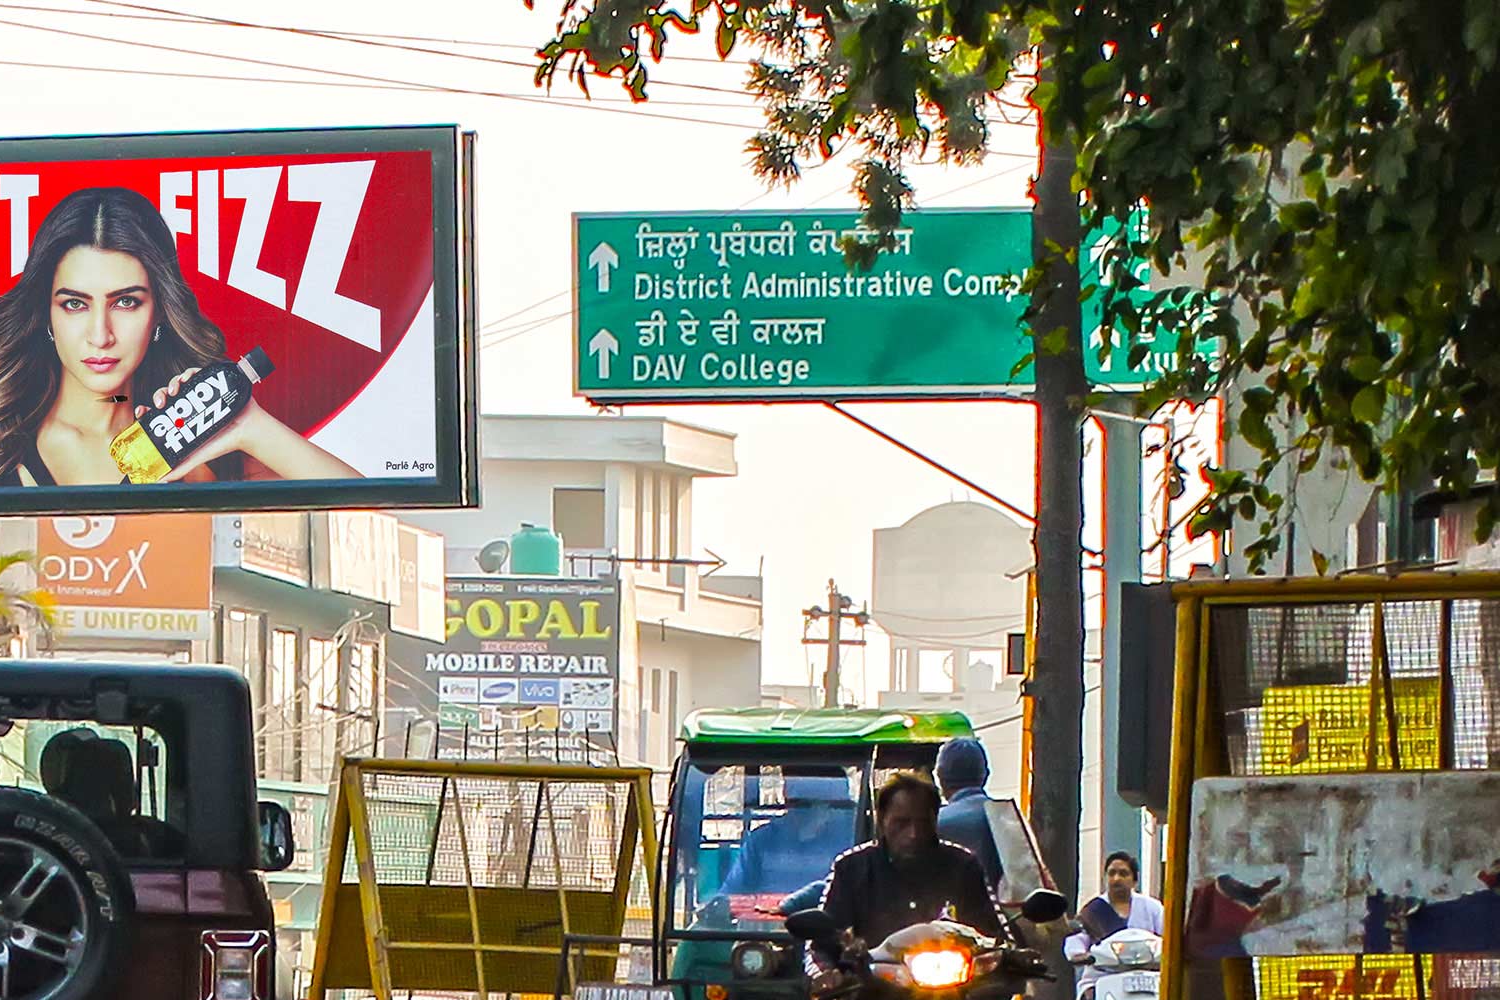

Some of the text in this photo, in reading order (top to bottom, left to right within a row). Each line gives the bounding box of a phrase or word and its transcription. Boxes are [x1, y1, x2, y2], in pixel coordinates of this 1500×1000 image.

[160, 160, 381, 352] FIZZ
[635, 273, 731, 300] District
[743, 271, 932, 298] Administrative
[635, 309, 826, 346] ਡੀ ਏ ਵੀ ਕਾਲਜ
[633, 352, 810, 385] DAV College
[149, 371, 229, 437] appy
[164, 398, 231, 453] fizz
[411, 460, 435, 472] Agro
[39, 541, 150, 594] ODYX
[83, 610, 198, 632] UNIFORM
[426, 652, 608, 674] MOBILE REPAIR
